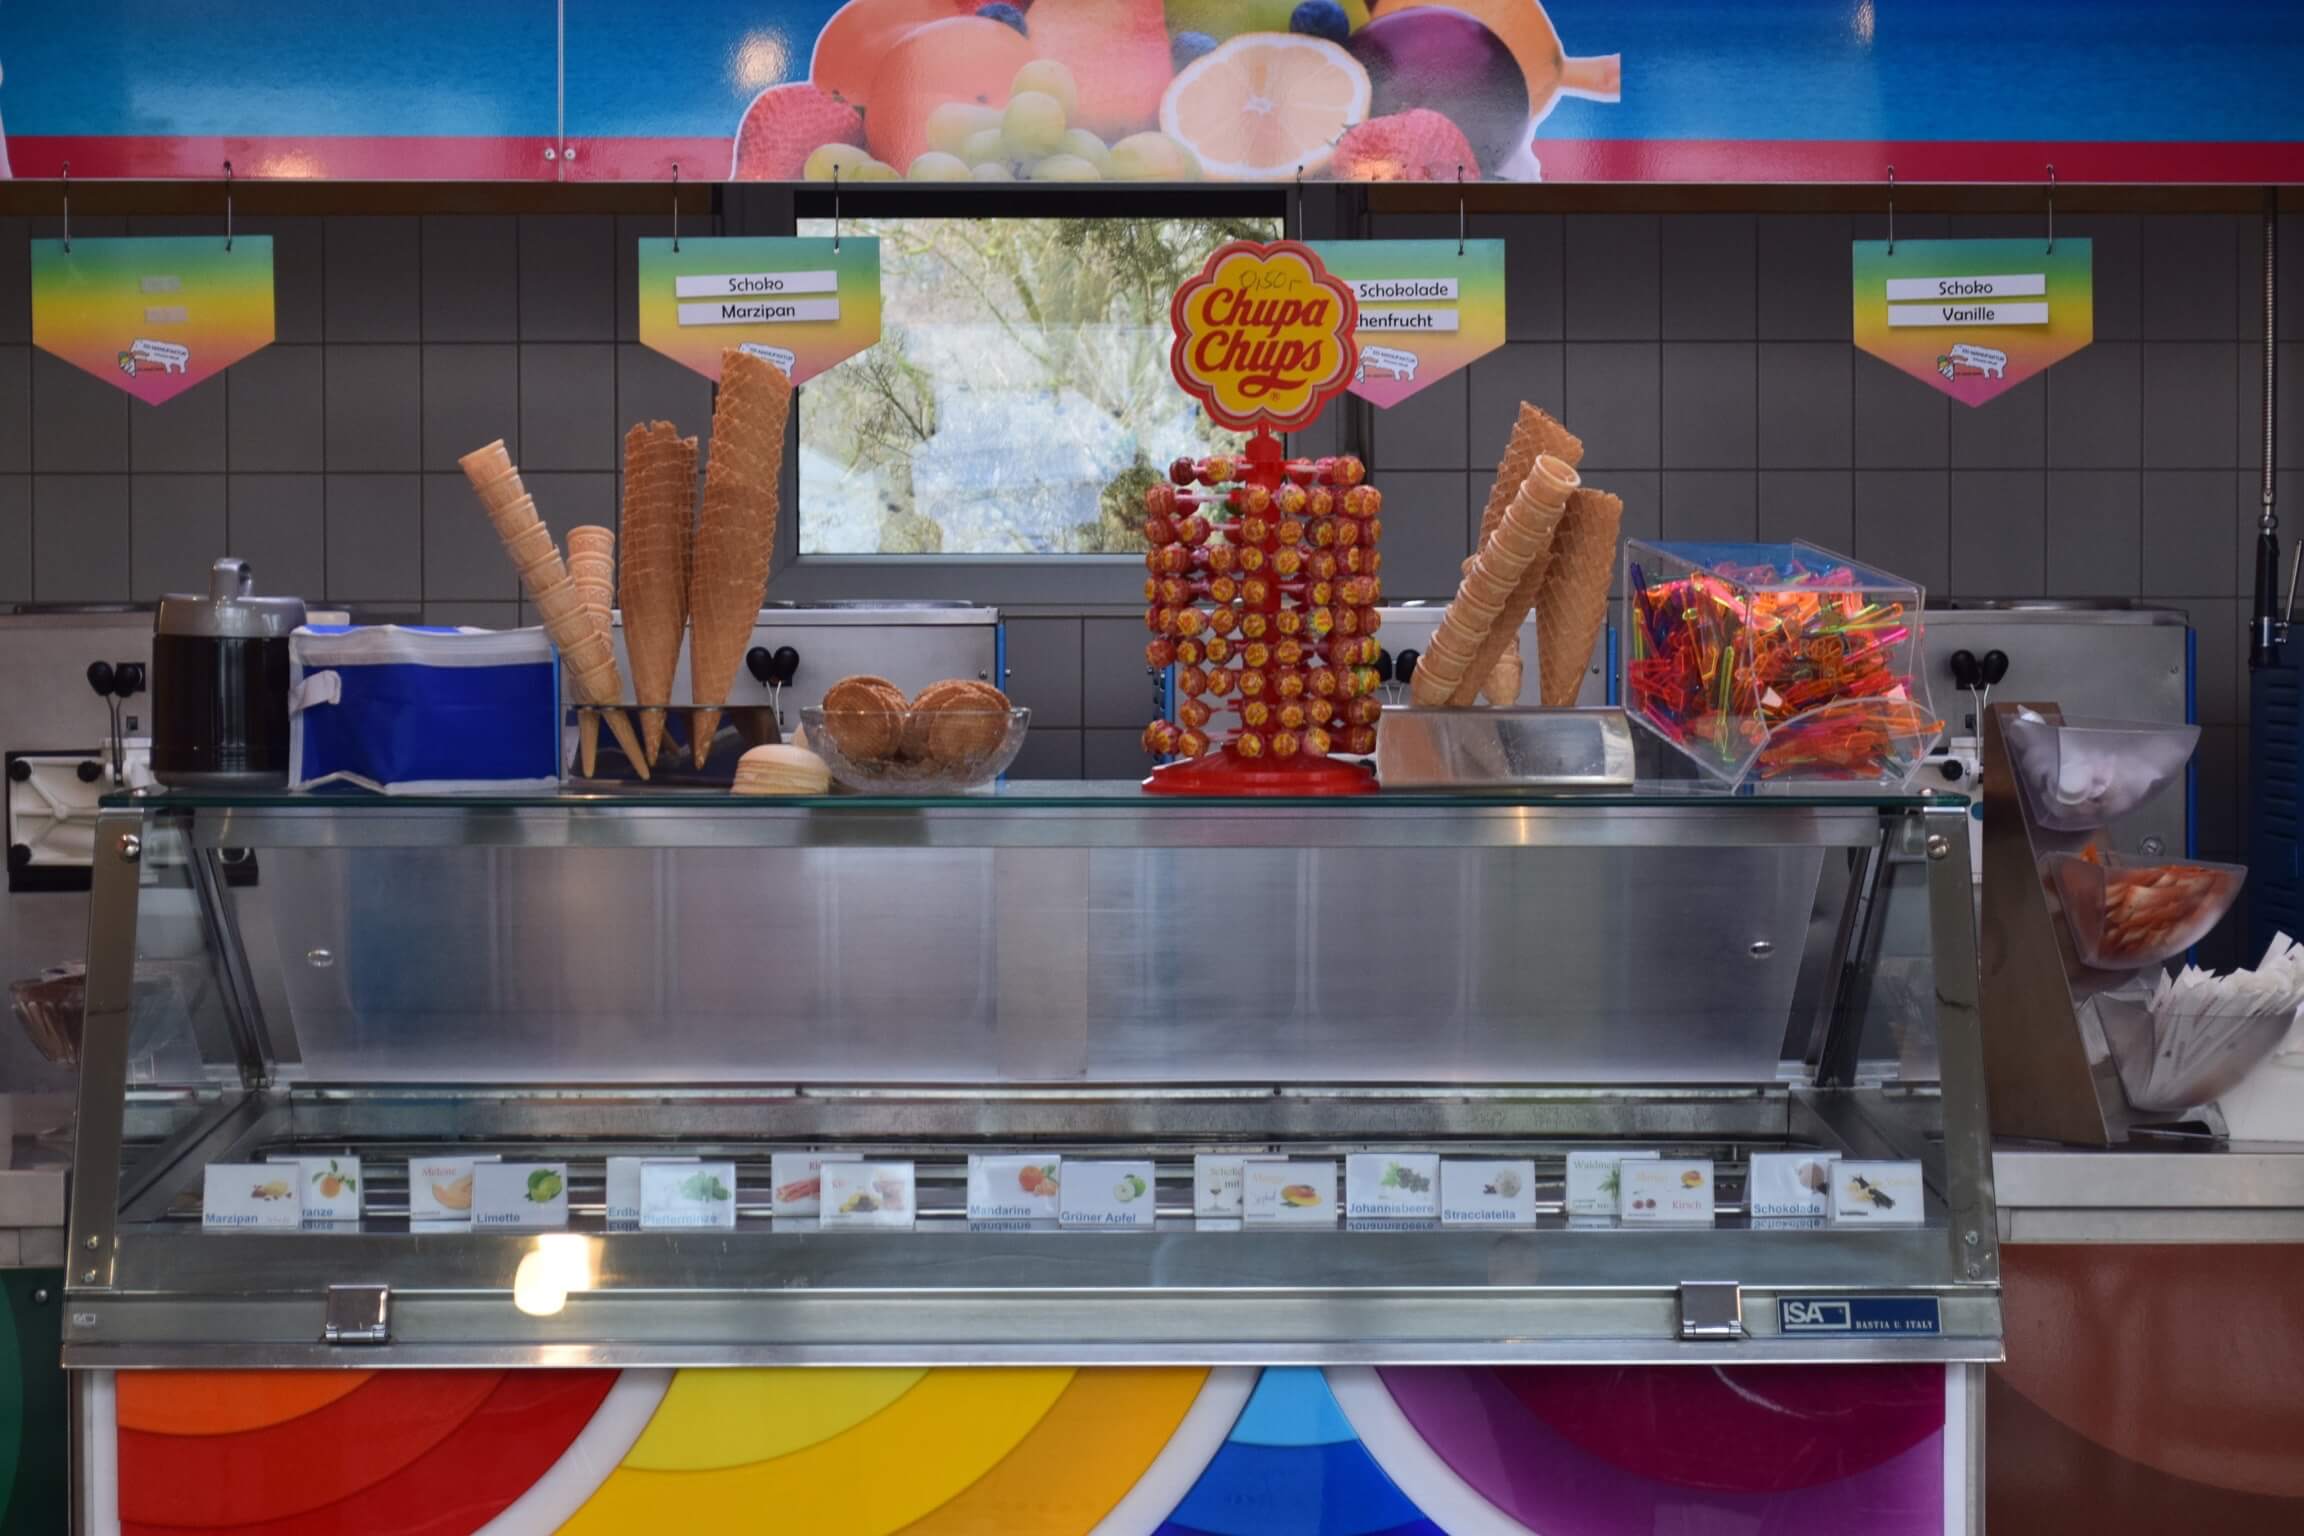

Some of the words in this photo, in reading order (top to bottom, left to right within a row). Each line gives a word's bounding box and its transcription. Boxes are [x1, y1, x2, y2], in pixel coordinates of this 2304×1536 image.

[729, 276, 784, 292] Schoko
[1360, 282, 1448, 298] Schokolade
[1939, 280, 1993, 296] Schoko
[722, 304, 795, 320] Marzipan
[1202, 288, 1331, 337] Chupa
[1943, 307, 1995, 321] Vanille
[1355, 313, 1433, 328] henfrucht
[1195, 329, 1323, 397] Chups
[970, 1205, 1031, 1216] Mandarine
[1349, 1203, 1434, 1214] Johannisbeere
[1444, 1209, 1516, 1220] Stracciatella
[1754, 1203, 1820, 1214] Schokolade
[206, 1213, 258, 1226] Marzipan
[476, 1212, 521, 1223] Limette
[1061, 1211, 1101, 1222] Grüner
[1105, 1212, 1136, 1223] Apfel
[1906, 1319, 1933, 1329] ITALY
